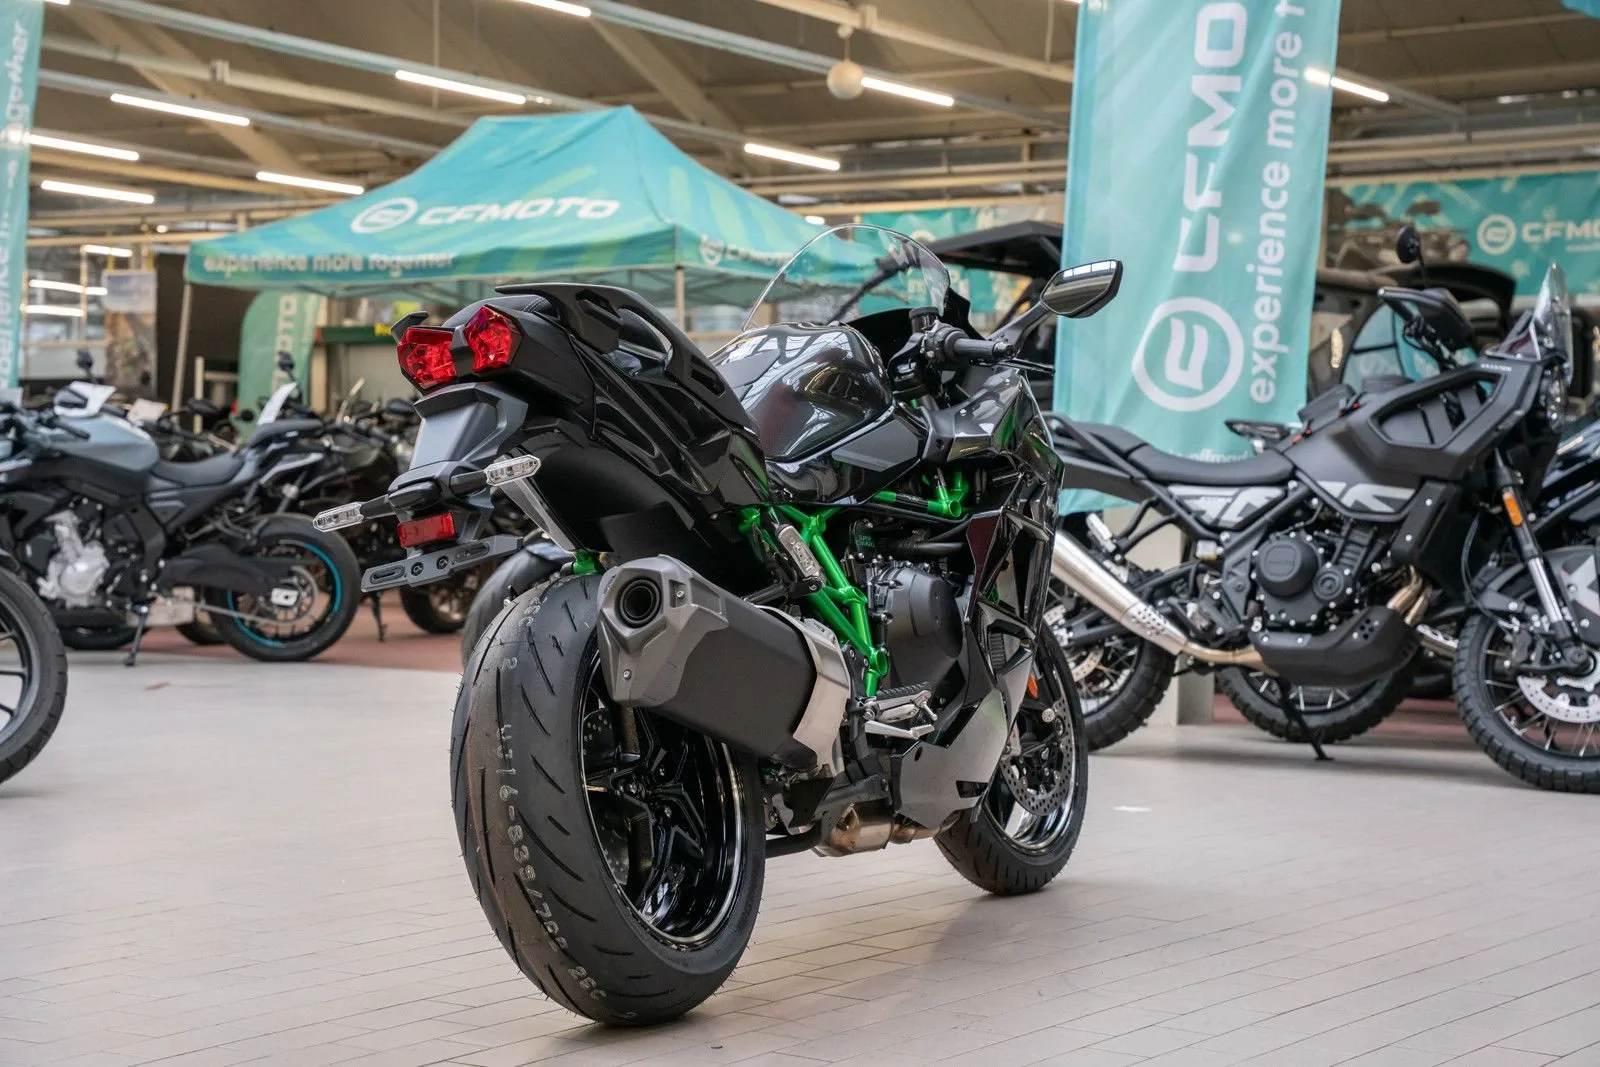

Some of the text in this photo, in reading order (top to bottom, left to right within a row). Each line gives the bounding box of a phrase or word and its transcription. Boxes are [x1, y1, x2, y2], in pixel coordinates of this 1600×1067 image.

[1266, 31, 1302, 149] more
[416, 197, 620, 226] CFMOTO
[203, 252, 307, 277] experience
[312, 251, 363, 272] more
[1249, 162, 1290, 404] experience
